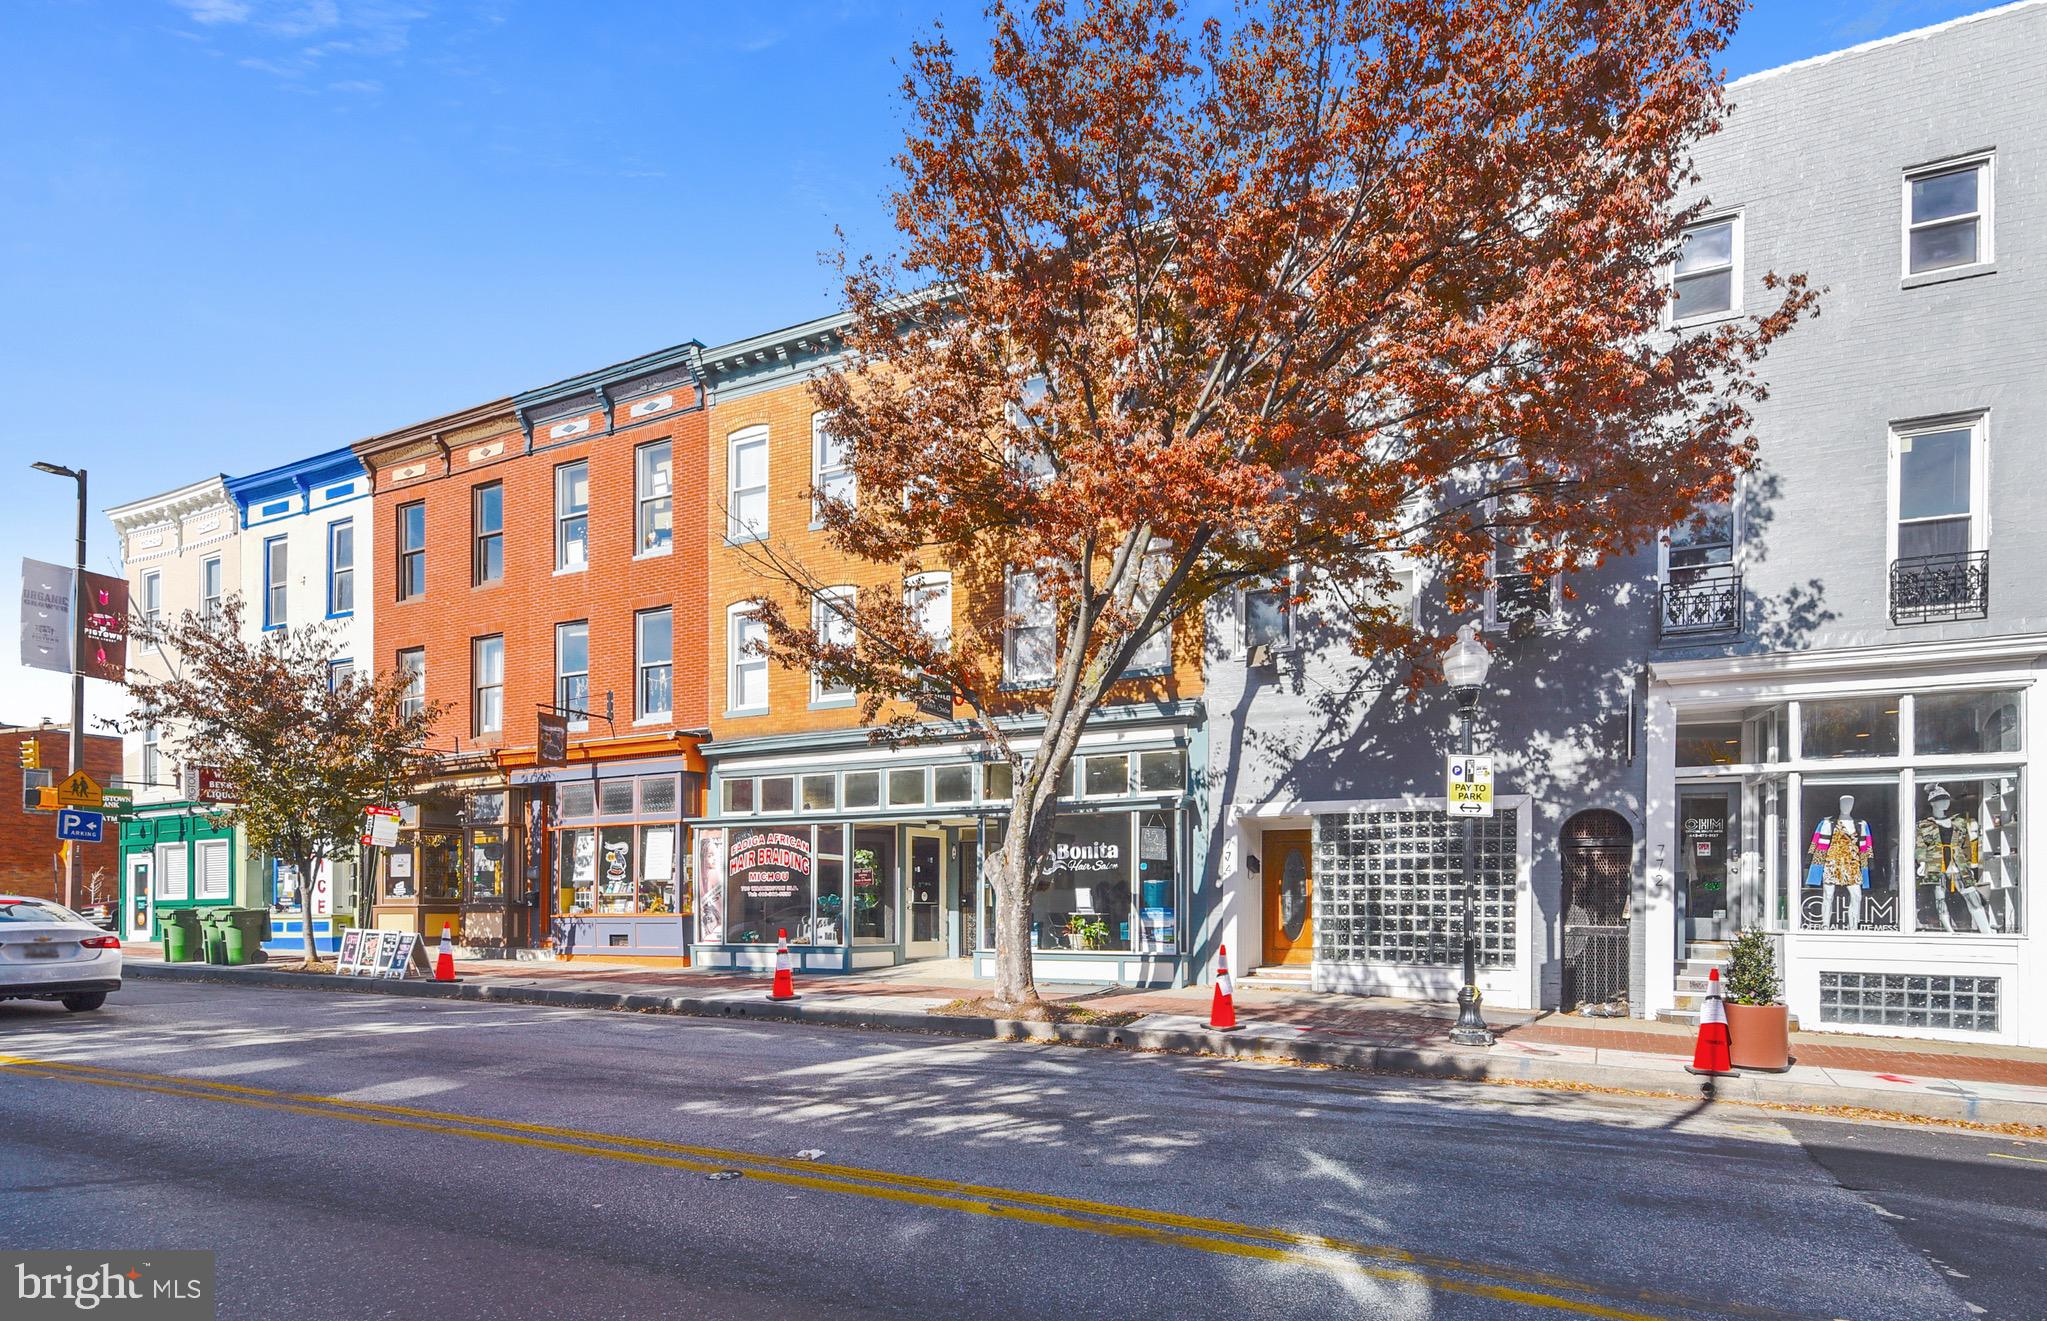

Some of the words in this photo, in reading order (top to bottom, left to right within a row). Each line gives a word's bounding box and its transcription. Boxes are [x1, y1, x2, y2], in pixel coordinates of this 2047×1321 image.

[84, 627, 123, 641] PIGTOWN
[1455, 783, 1471, 792] PAY
[1474, 784, 1486, 792] TO
[1458, 792, 1482, 800] PARK
[767, 833, 809, 853] AFRICAN
[1056, 841, 1119, 860] Bonita
[729, 851, 755, 876] HAIR
[758, 848, 810, 875] BRAIDING
[1067, 859, 1091, 872] Hair
[1655, 844, 1665, 887] 772
[749, 871, 789, 882] MICHOU
[1801, 923, 1840, 931] OFFICAL
